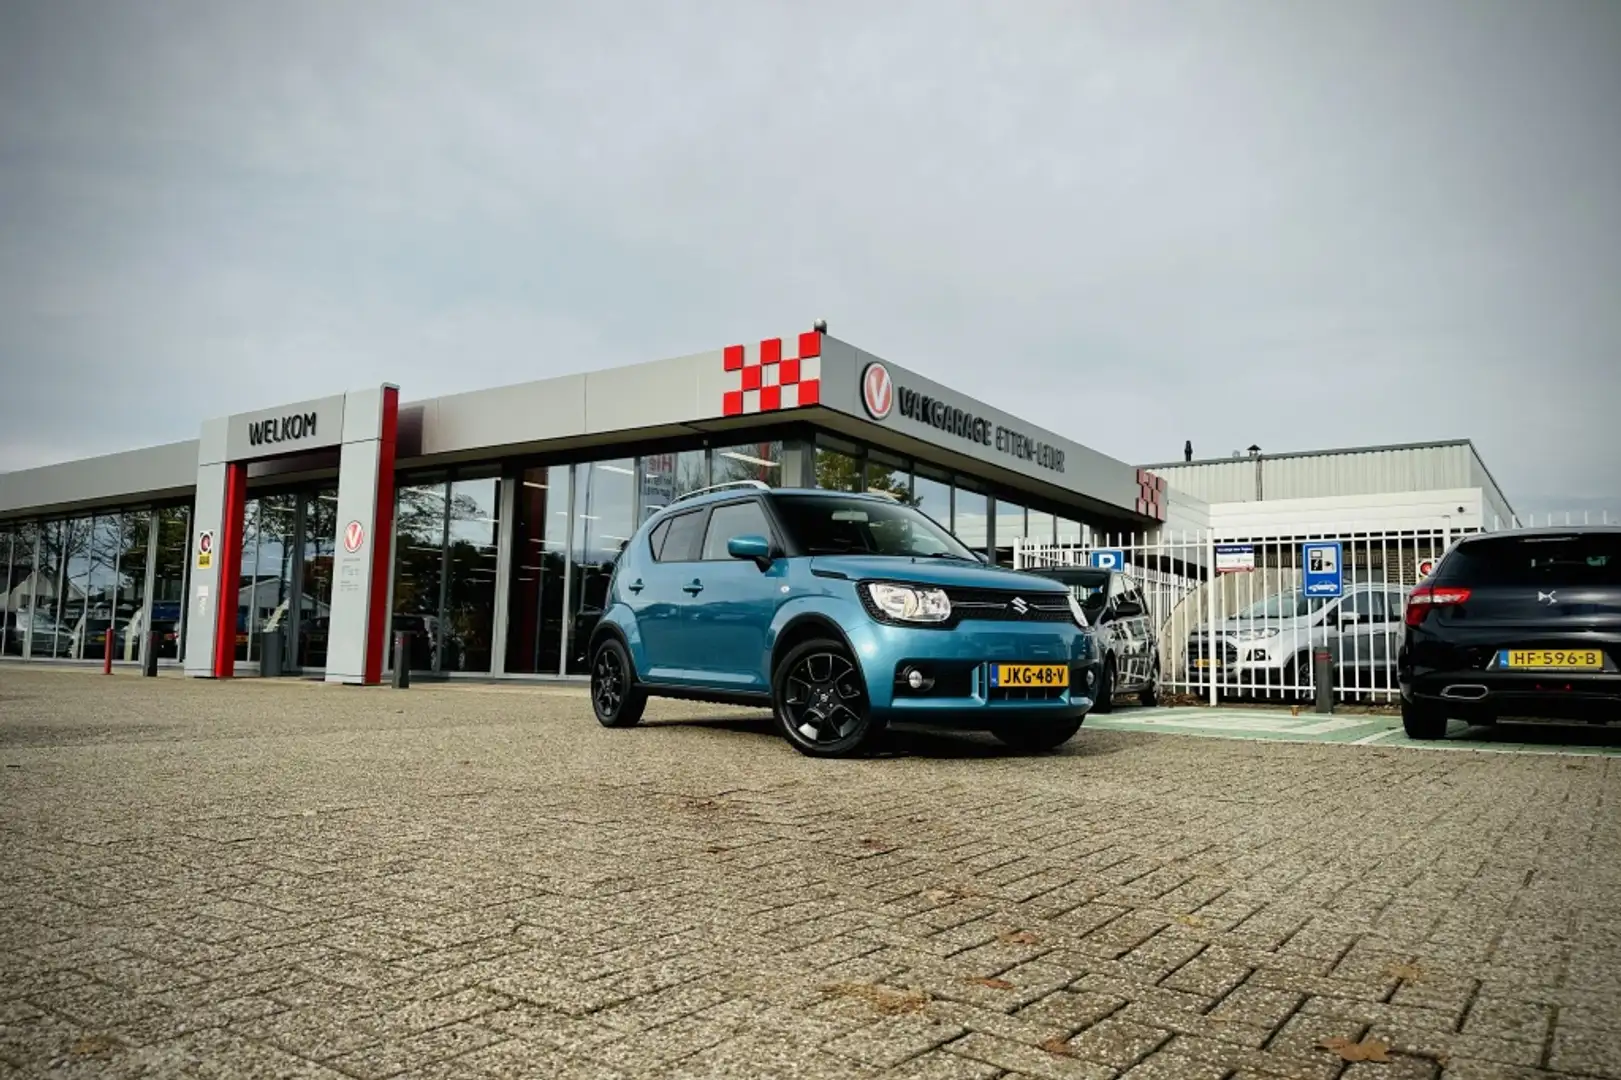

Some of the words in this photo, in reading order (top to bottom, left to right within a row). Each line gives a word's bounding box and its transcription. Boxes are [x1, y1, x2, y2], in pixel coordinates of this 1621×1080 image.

[248, 411, 317, 446] WELKOM
[898, 386, 992, 446] VAKGARAGE
[996, 425, 1066, 473] ETTEN-LEUR
[1514, 652, 1597, 665] HF-596-B
[1003, 667, 1065, 684] JKG-48-V
